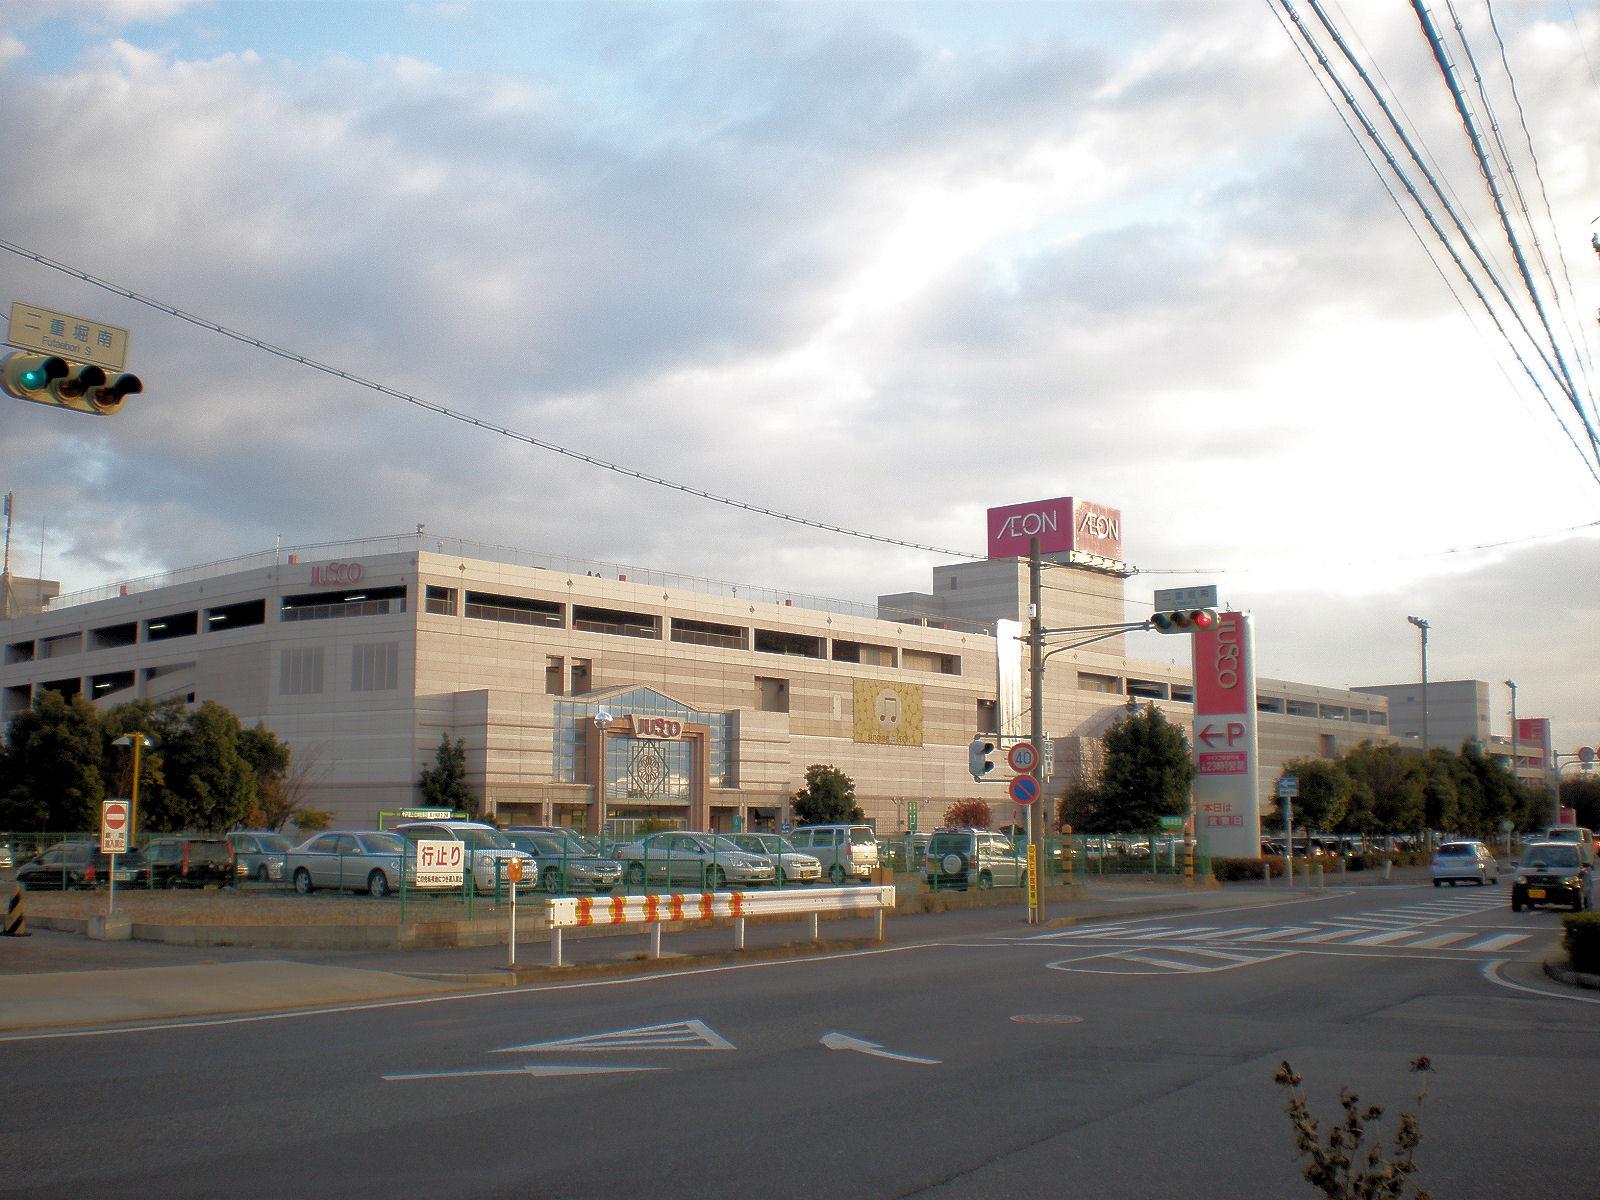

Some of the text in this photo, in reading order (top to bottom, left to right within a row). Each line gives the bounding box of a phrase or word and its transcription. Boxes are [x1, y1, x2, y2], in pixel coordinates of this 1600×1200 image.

[24, 312, 113, 348] 二重堀南
[85, 346, 92, 355] S
[310, 562, 364, 587] JUSCO
[637, 718, 681, 738] JUSCO
[1227, 722, 1245, 747] P
[1015, 751, 1032, 765] 40
[421, 846, 461, 866] 行止り
